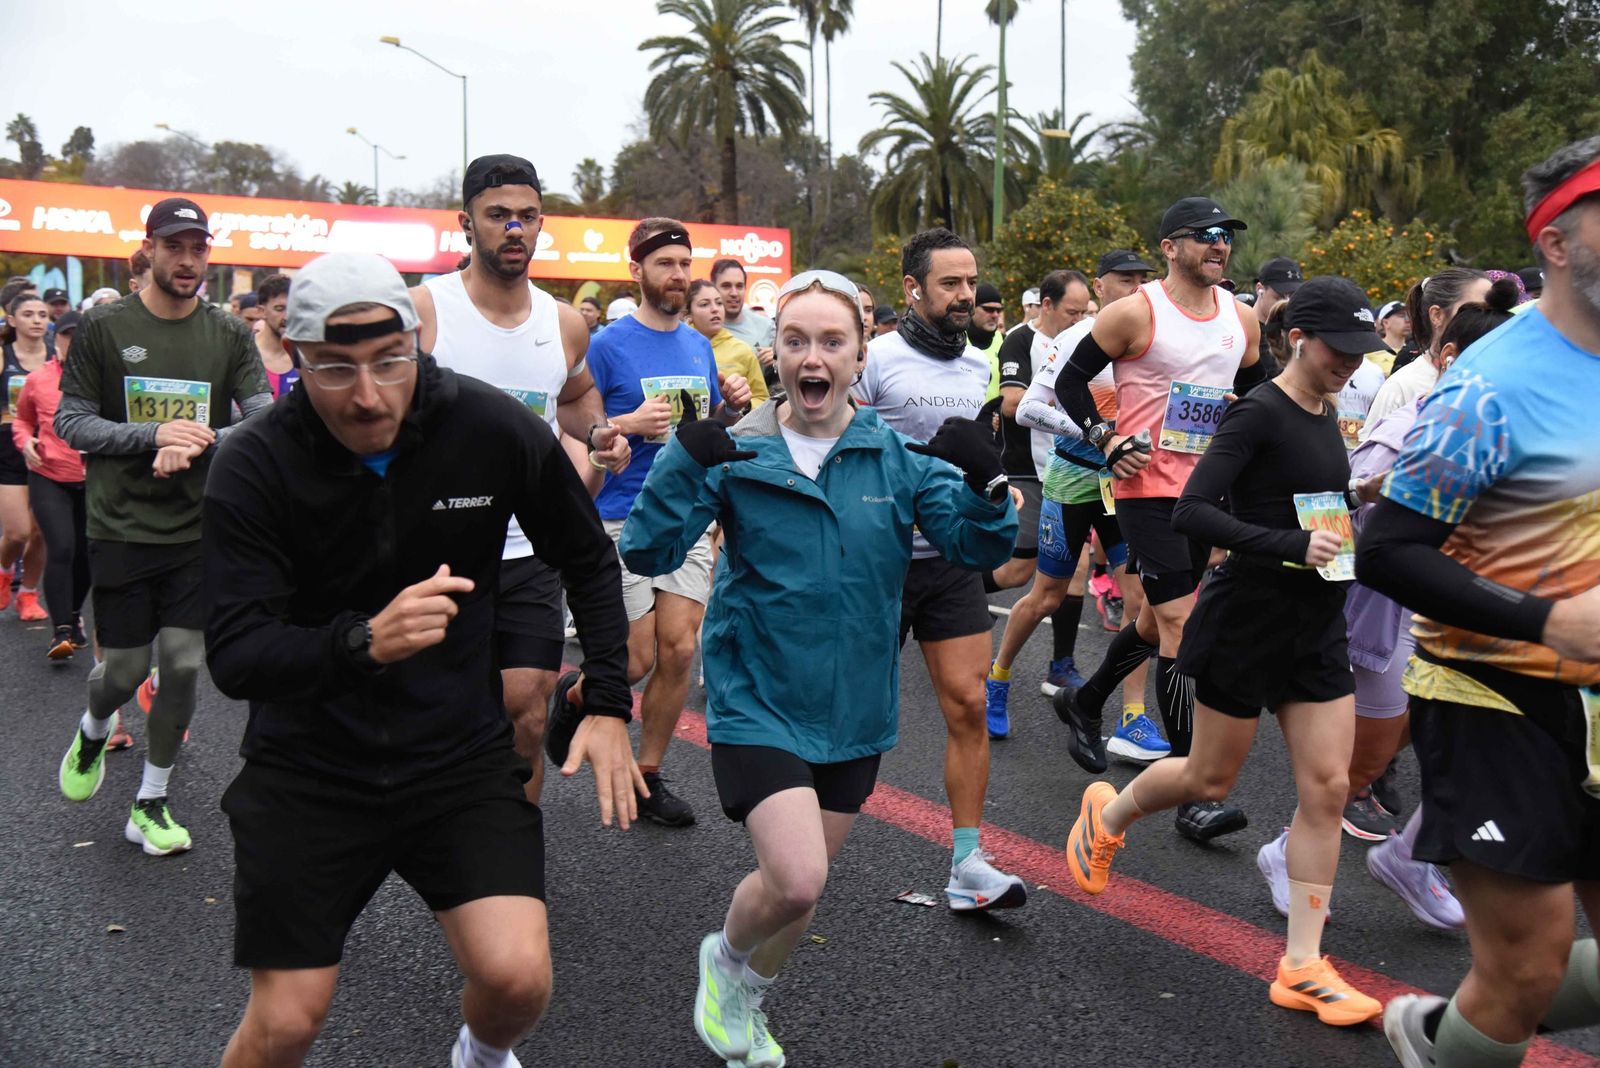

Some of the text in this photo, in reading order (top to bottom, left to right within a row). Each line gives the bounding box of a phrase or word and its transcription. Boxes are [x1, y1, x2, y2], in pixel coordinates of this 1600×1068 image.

[134, 397, 197, 420] 13123
[903, 396, 984, 409] ANDBANK
[448, 496, 494, 509] TERREX
